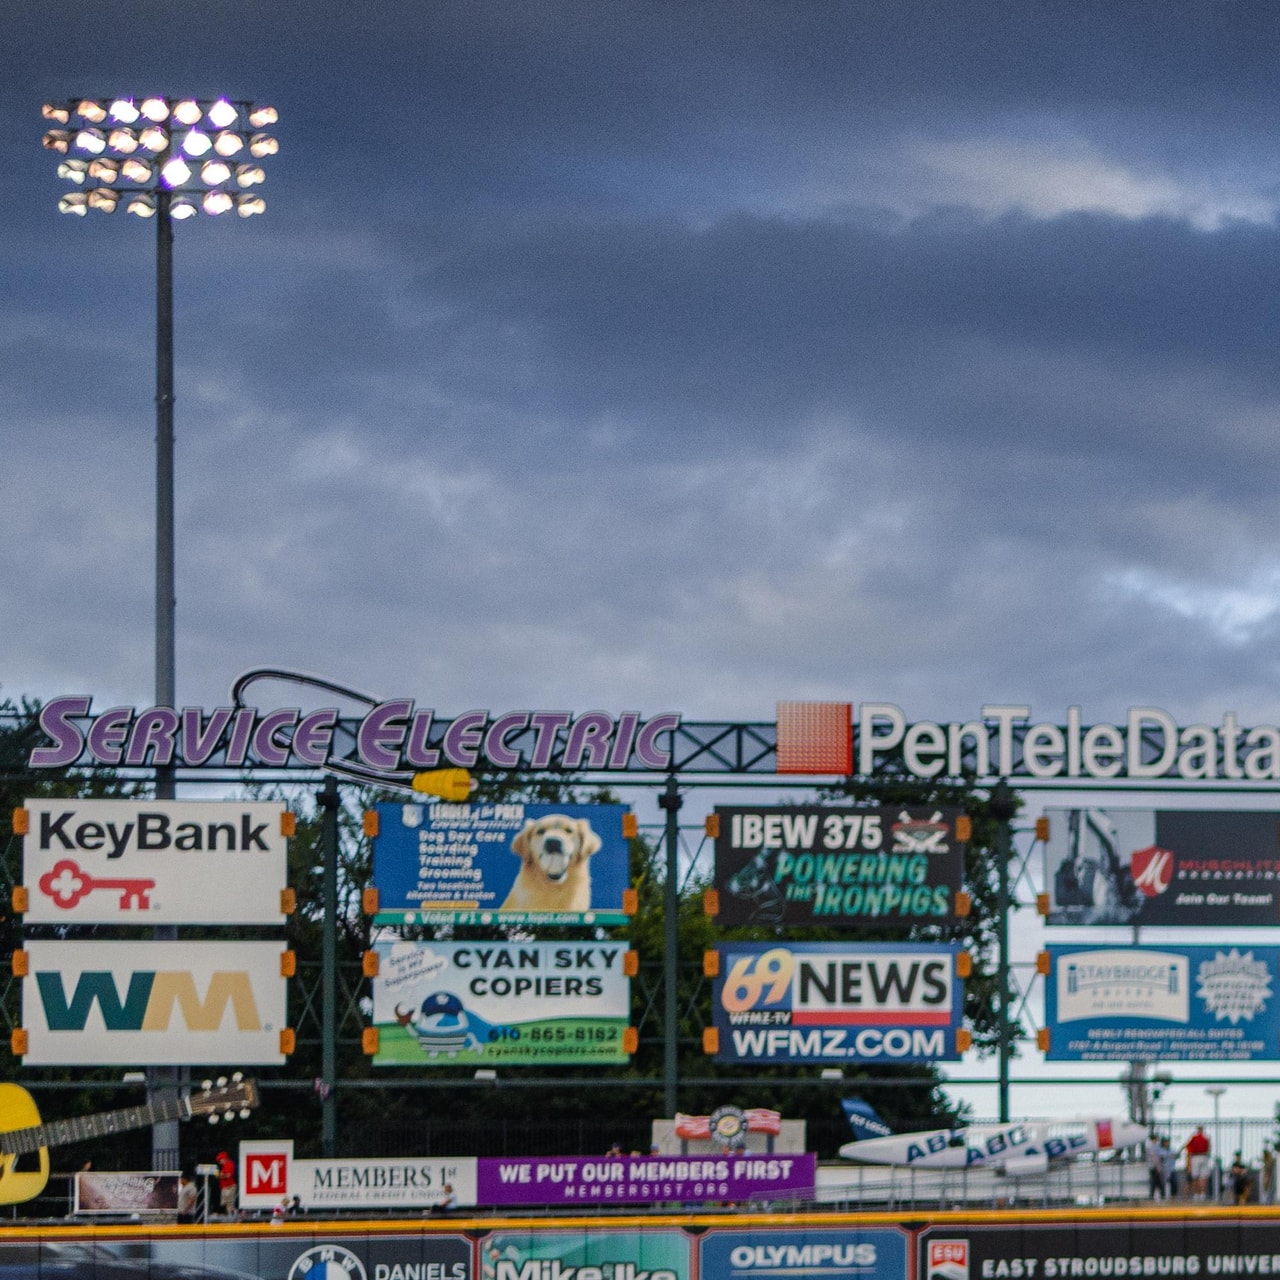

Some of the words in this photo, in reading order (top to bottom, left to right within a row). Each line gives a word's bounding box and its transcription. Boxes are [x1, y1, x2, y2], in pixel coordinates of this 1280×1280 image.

[28, 695, 339, 768] SERVICE
[356, 698, 682, 769] ELECTRIC
[40, 811, 271, 859] KeyBank
[731, 814, 818, 849] IBEW
[823, 814, 882, 849] 375
[775, 853, 929, 885] POWERING
[812, 884, 950, 917] IRONPIGS
[453, 949, 539, 969] CYAN
[555, 949, 618, 969] SKY
[469, 977, 603, 997] COPIERS
[721, 948, 794, 1012] 69
[799, 960, 948, 1005] NEWS
[35, 970, 262, 1032] WM
[733, 1029, 945, 1057] WFMZ.COM
[313, 1166, 432, 1188] MEMBERS
[499, 1163, 531, 1183] WE
[536, 1163, 578, 1183] PUT
[582, 1162, 624, 1183] OUR
[629, 1161, 729, 1182] MEMBERS
[734, 1160, 793, 1180] FIRST
[730, 1243, 877, 1268] OLYMPUS
[982, 1258, 1037, 1278] EAST
[1044, 1255, 1199, 1277] STROUDSBURG
